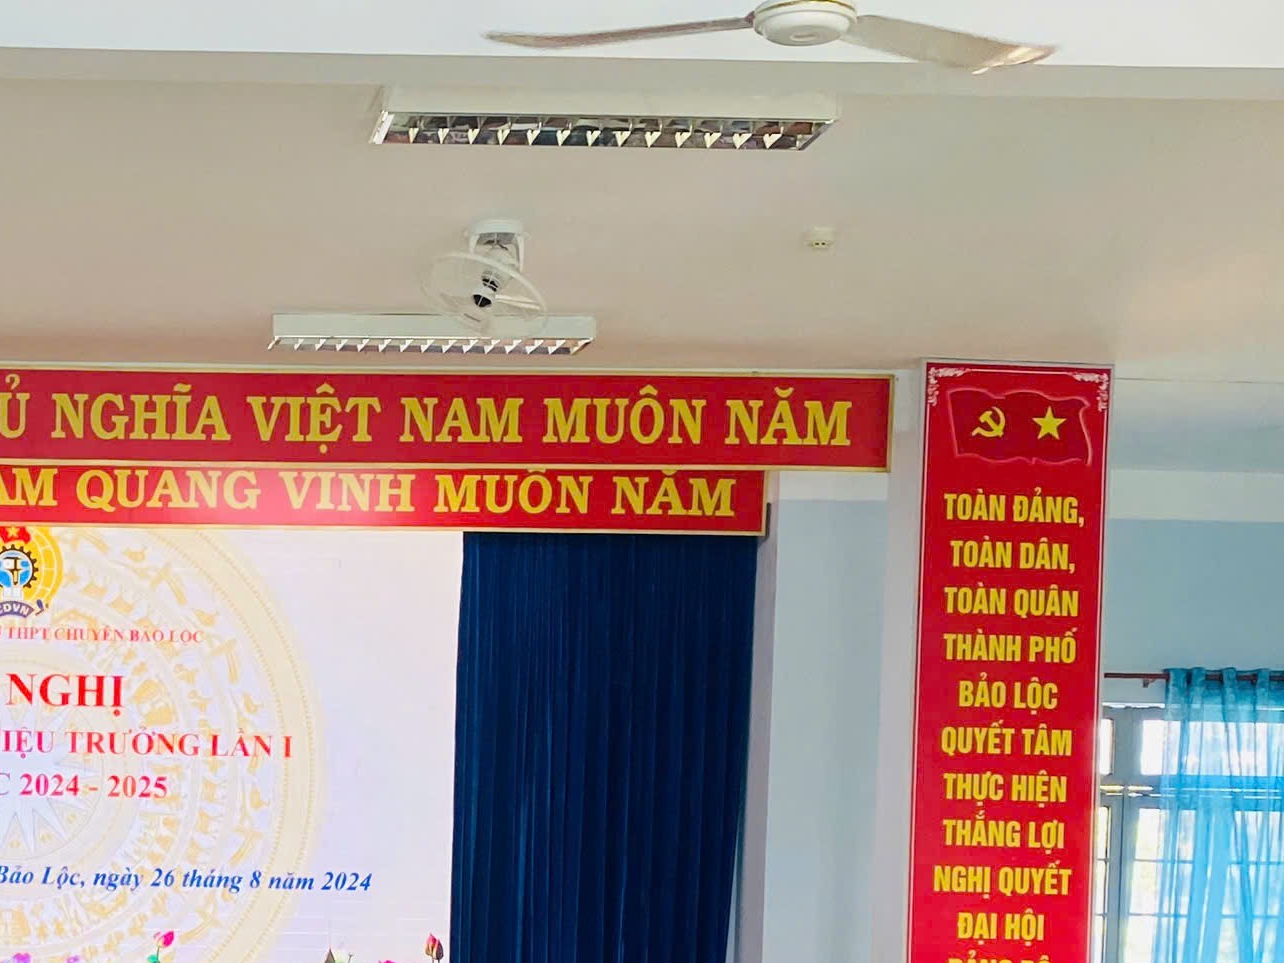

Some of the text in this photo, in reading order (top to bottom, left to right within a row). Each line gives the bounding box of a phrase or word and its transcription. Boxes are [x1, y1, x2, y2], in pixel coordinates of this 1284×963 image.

[51, 383, 231, 441] NGHĨA
[246, 383, 381, 454] VIỆT
[399, 396, 523, 443] NAM
[543, 385, 706, 444] MUÔN
[725, 387, 853, 446] NĂM
[76, 469, 261, 512] QUANG
[279, 471, 416, 512] VINH
[611, 469, 737, 517] NĂM
[944, 487, 1084, 527] TOÀN ĐẢNG,
[950, 535, 1075, 574] TOÀN DÂN,
[944, 582, 1079, 618] TOÀN QUÂN
[7, 626, 50, 640] THPT
[943, 627, 1078, 663] THÀNH PHỐ
[5, 673, 124, 717] NGHỊ
[959, 672, 1058, 715] BẢO LỘC
[65, 726, 200, 756] TRƯỞNG
[210, 728, 272, 758] LẦN
[282, 735, 293, 758] I
[941, 719, 1072, 757] QUYẾT TÂM
[19, 773, 80, 796] 2024
[107, 775, 168, 798] 2025
[943, 769, 1067, 808] THỰC HIỆN
[943, 810, 1065, 855] THẮNG LỢI
[41, 866, 85, 890] Lộc,
[93, 867, 144, 892] ngày
[151, 868, 175, 887] 26
[181, 868, 244, 894] tháng
[249, 869, 262, 889] 8
[268, 872, 315, 890] năm
[321, 872, 373, 891] 2024
[933, 859, 1072, 899] NGHỊ QUYẾT
[957, 908, 1045, 946] ĐẠI HỘI
